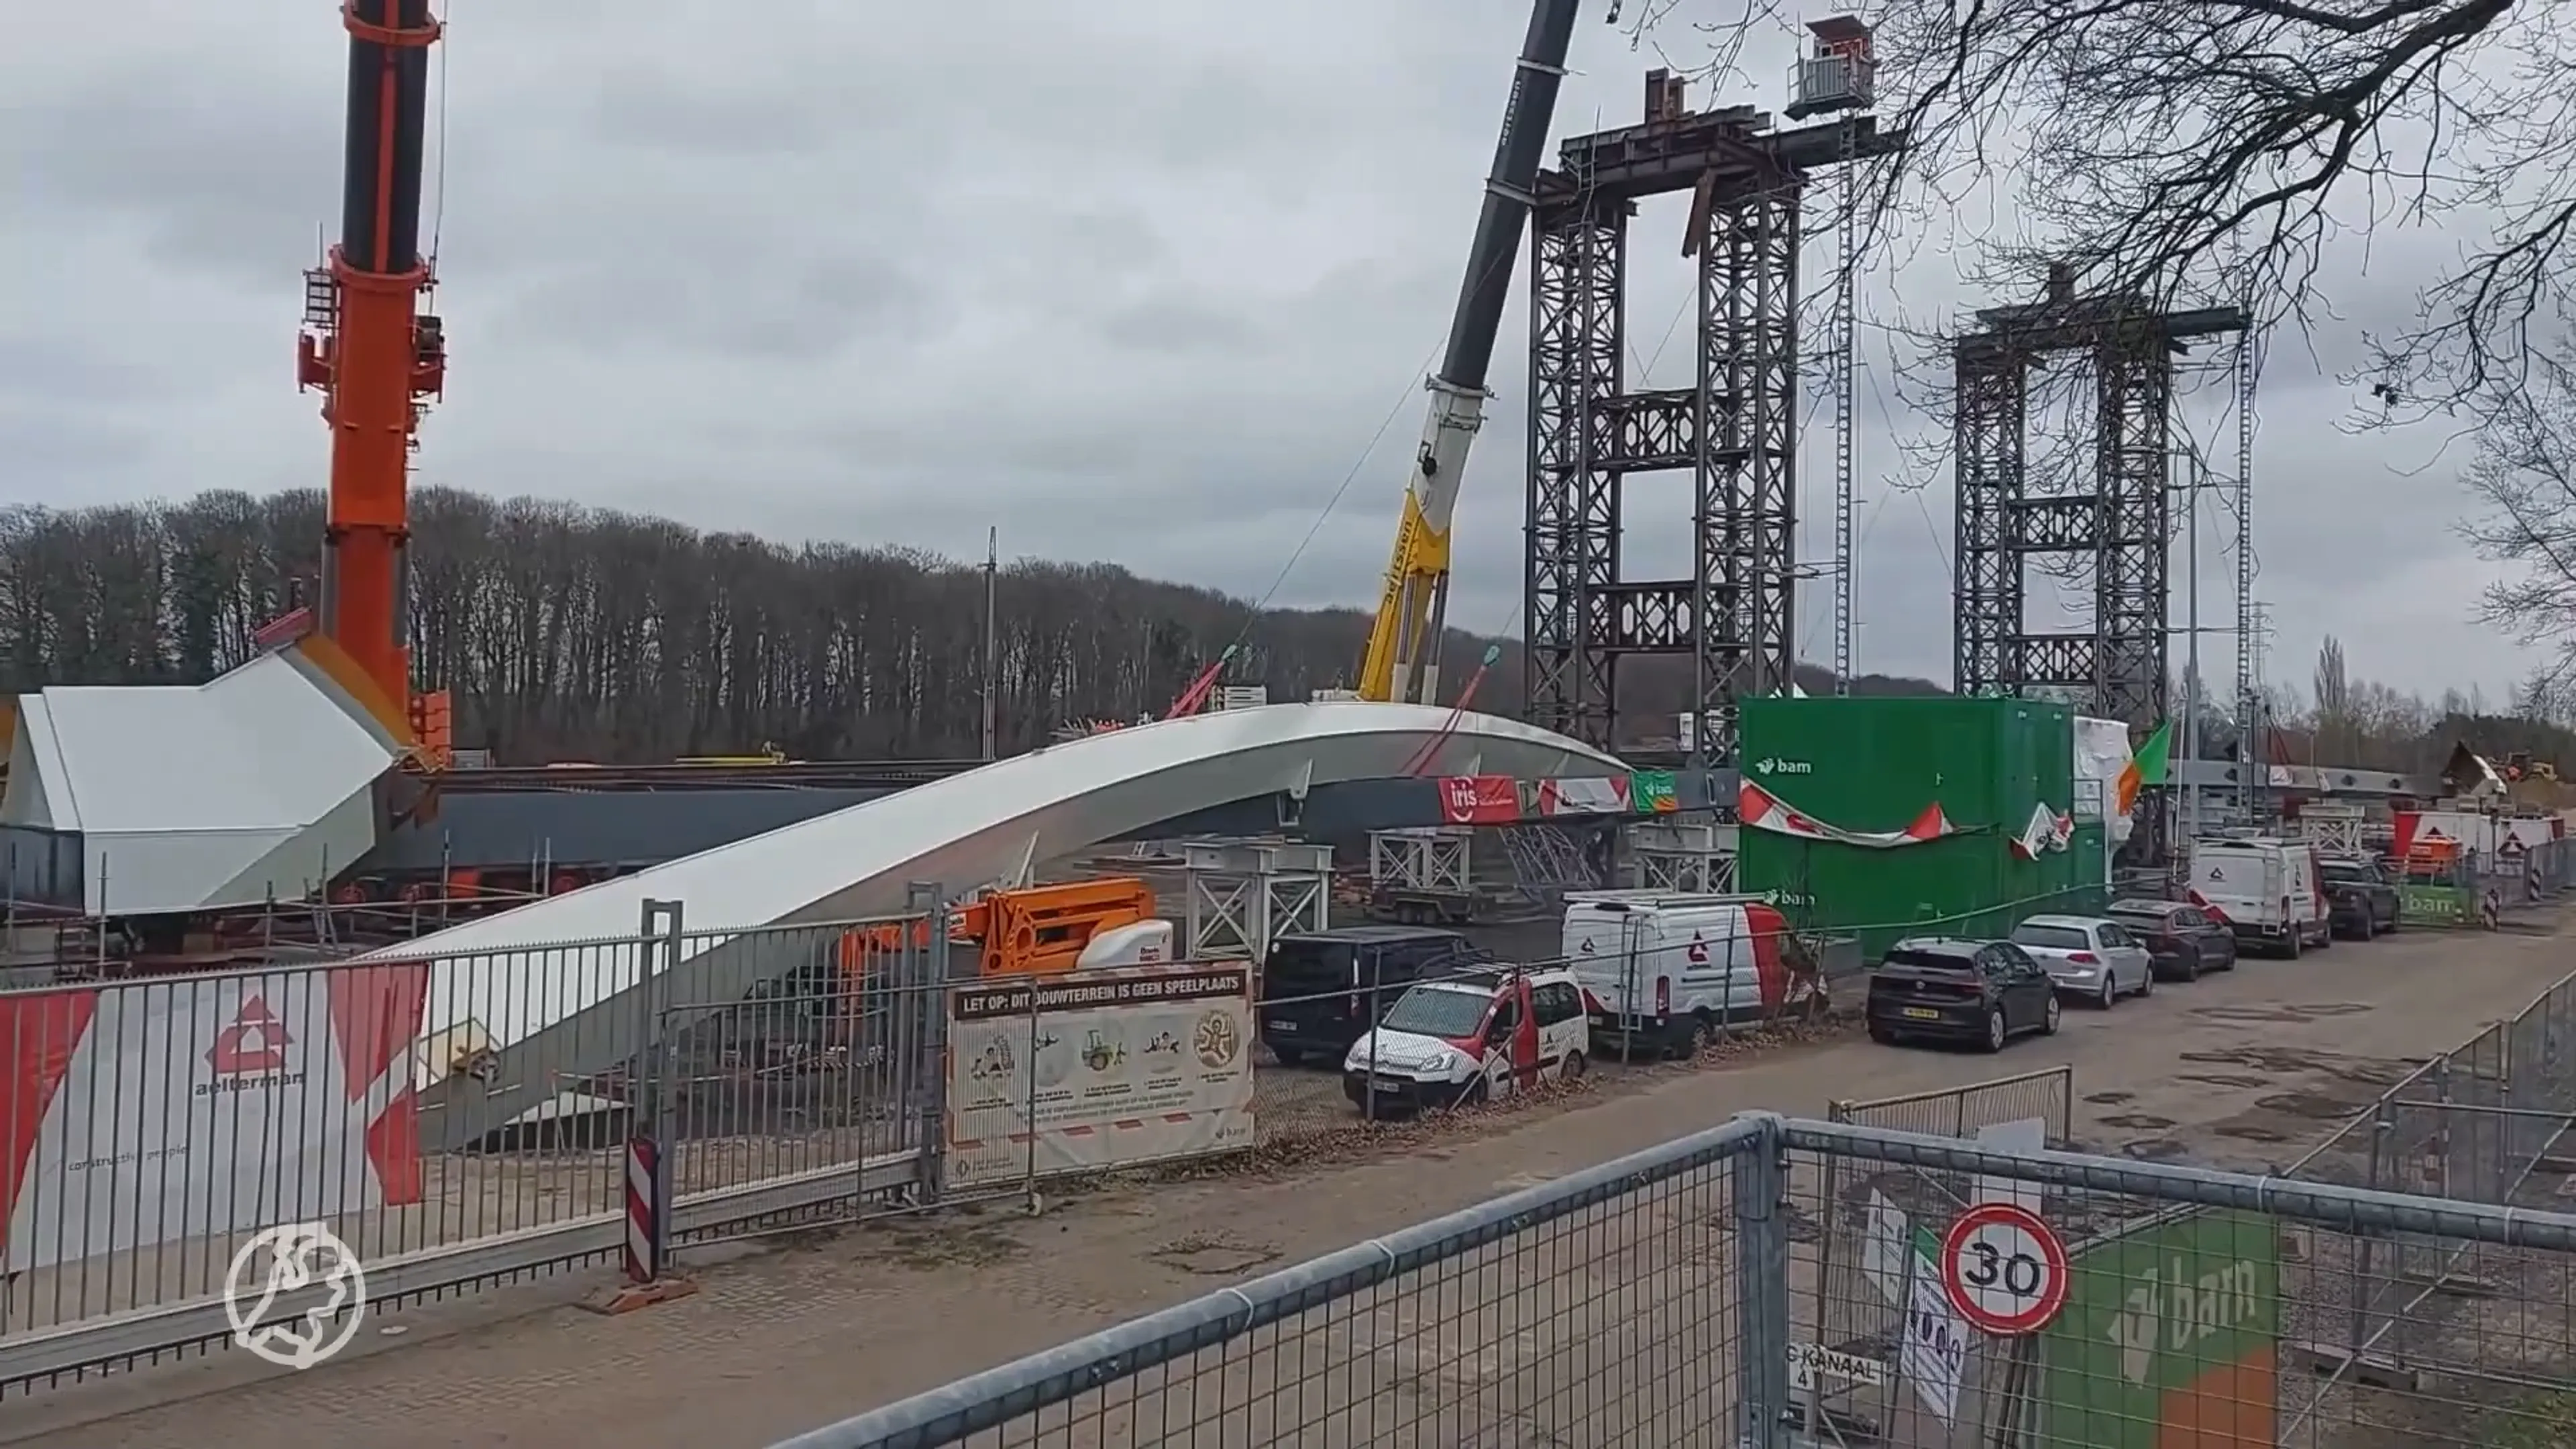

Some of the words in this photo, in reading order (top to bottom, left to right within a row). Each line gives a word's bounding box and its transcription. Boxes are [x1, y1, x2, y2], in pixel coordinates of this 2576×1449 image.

[1778, 757, 1811, 773] bam
[1450, 782, 1477, 807] iris
[963, 997, 985, 1012] LET
[988, 995, 1008, 1010] OP:
[1012, 993, 1031, 1008] DIT
[1118, 984, 1130, 999] IS
[1132, 981, 1162, 996] GEEN
[1165, 976, 1240, 994] SPEELPLAATS
[68, 1152, 138, 1171] constructiv
[146, 1143, 189, 1161] peple
[1965, 1242, 2040, 1297] 30
[2172, 1256, 2255, 1349] bam
[1798, 1370, 1809, 1387] 4
[1803, 1348, 1876, 1380] KANAAL
